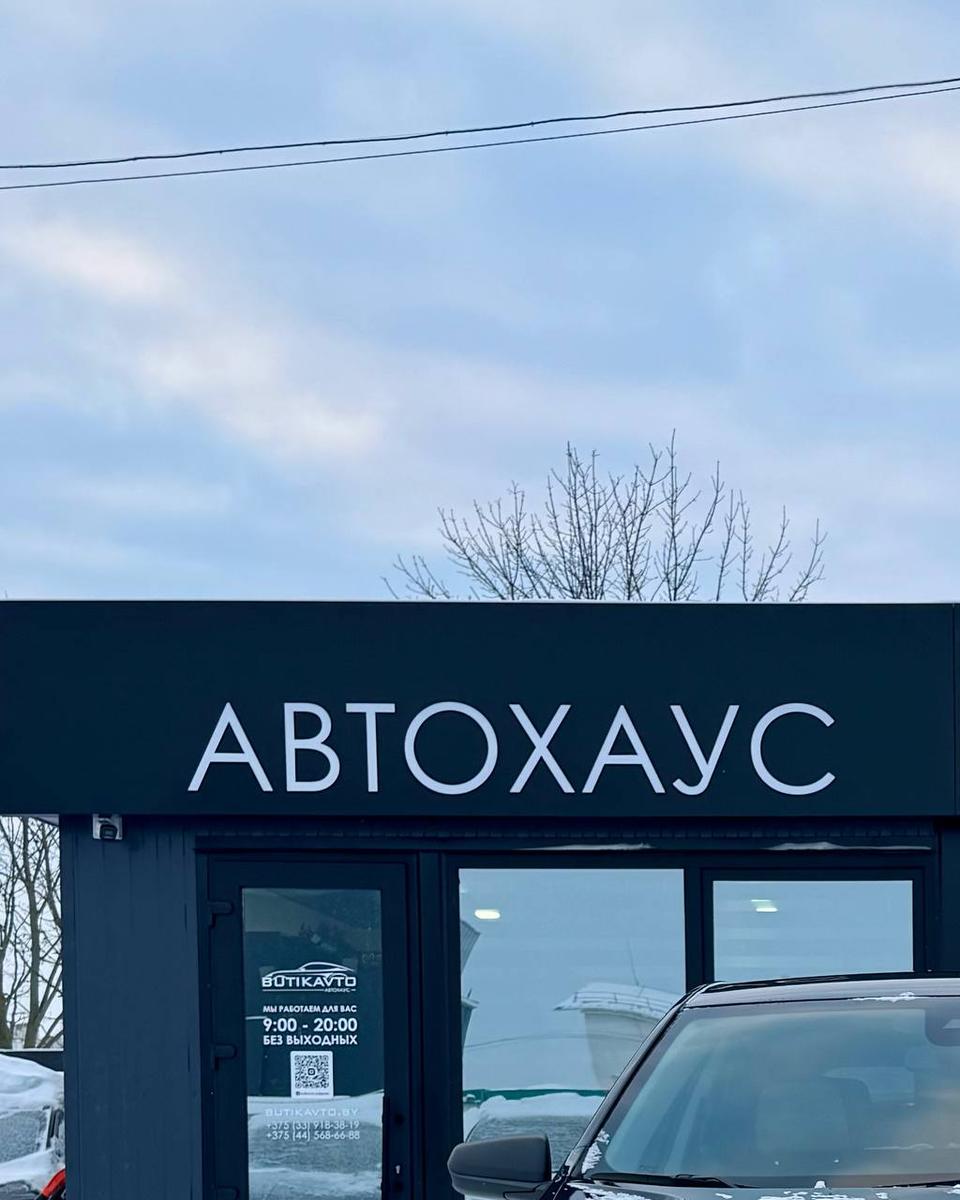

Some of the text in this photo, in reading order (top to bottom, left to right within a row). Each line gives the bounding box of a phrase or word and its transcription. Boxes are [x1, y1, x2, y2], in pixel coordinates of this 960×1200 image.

[188, 701, 836, 795] АВТОХАУС
[261, 976, 356, 987] BUTIKAVTO
[263, 1005, 357, 1013] МЫ РАБОТАЕМ ДЛЯ ВАС
[263, 1018, 297, 1032] 9:00
[313, 1018, 358, 1032] 20:00
[263, 1034, 358, 1046] БЕЗ ВЫХОДНЫХ
[266, 1120, 360, 1131] +375 (33) 918-38-19
[266, 1130, 360, 1141] +375 (44) 568-66-88
